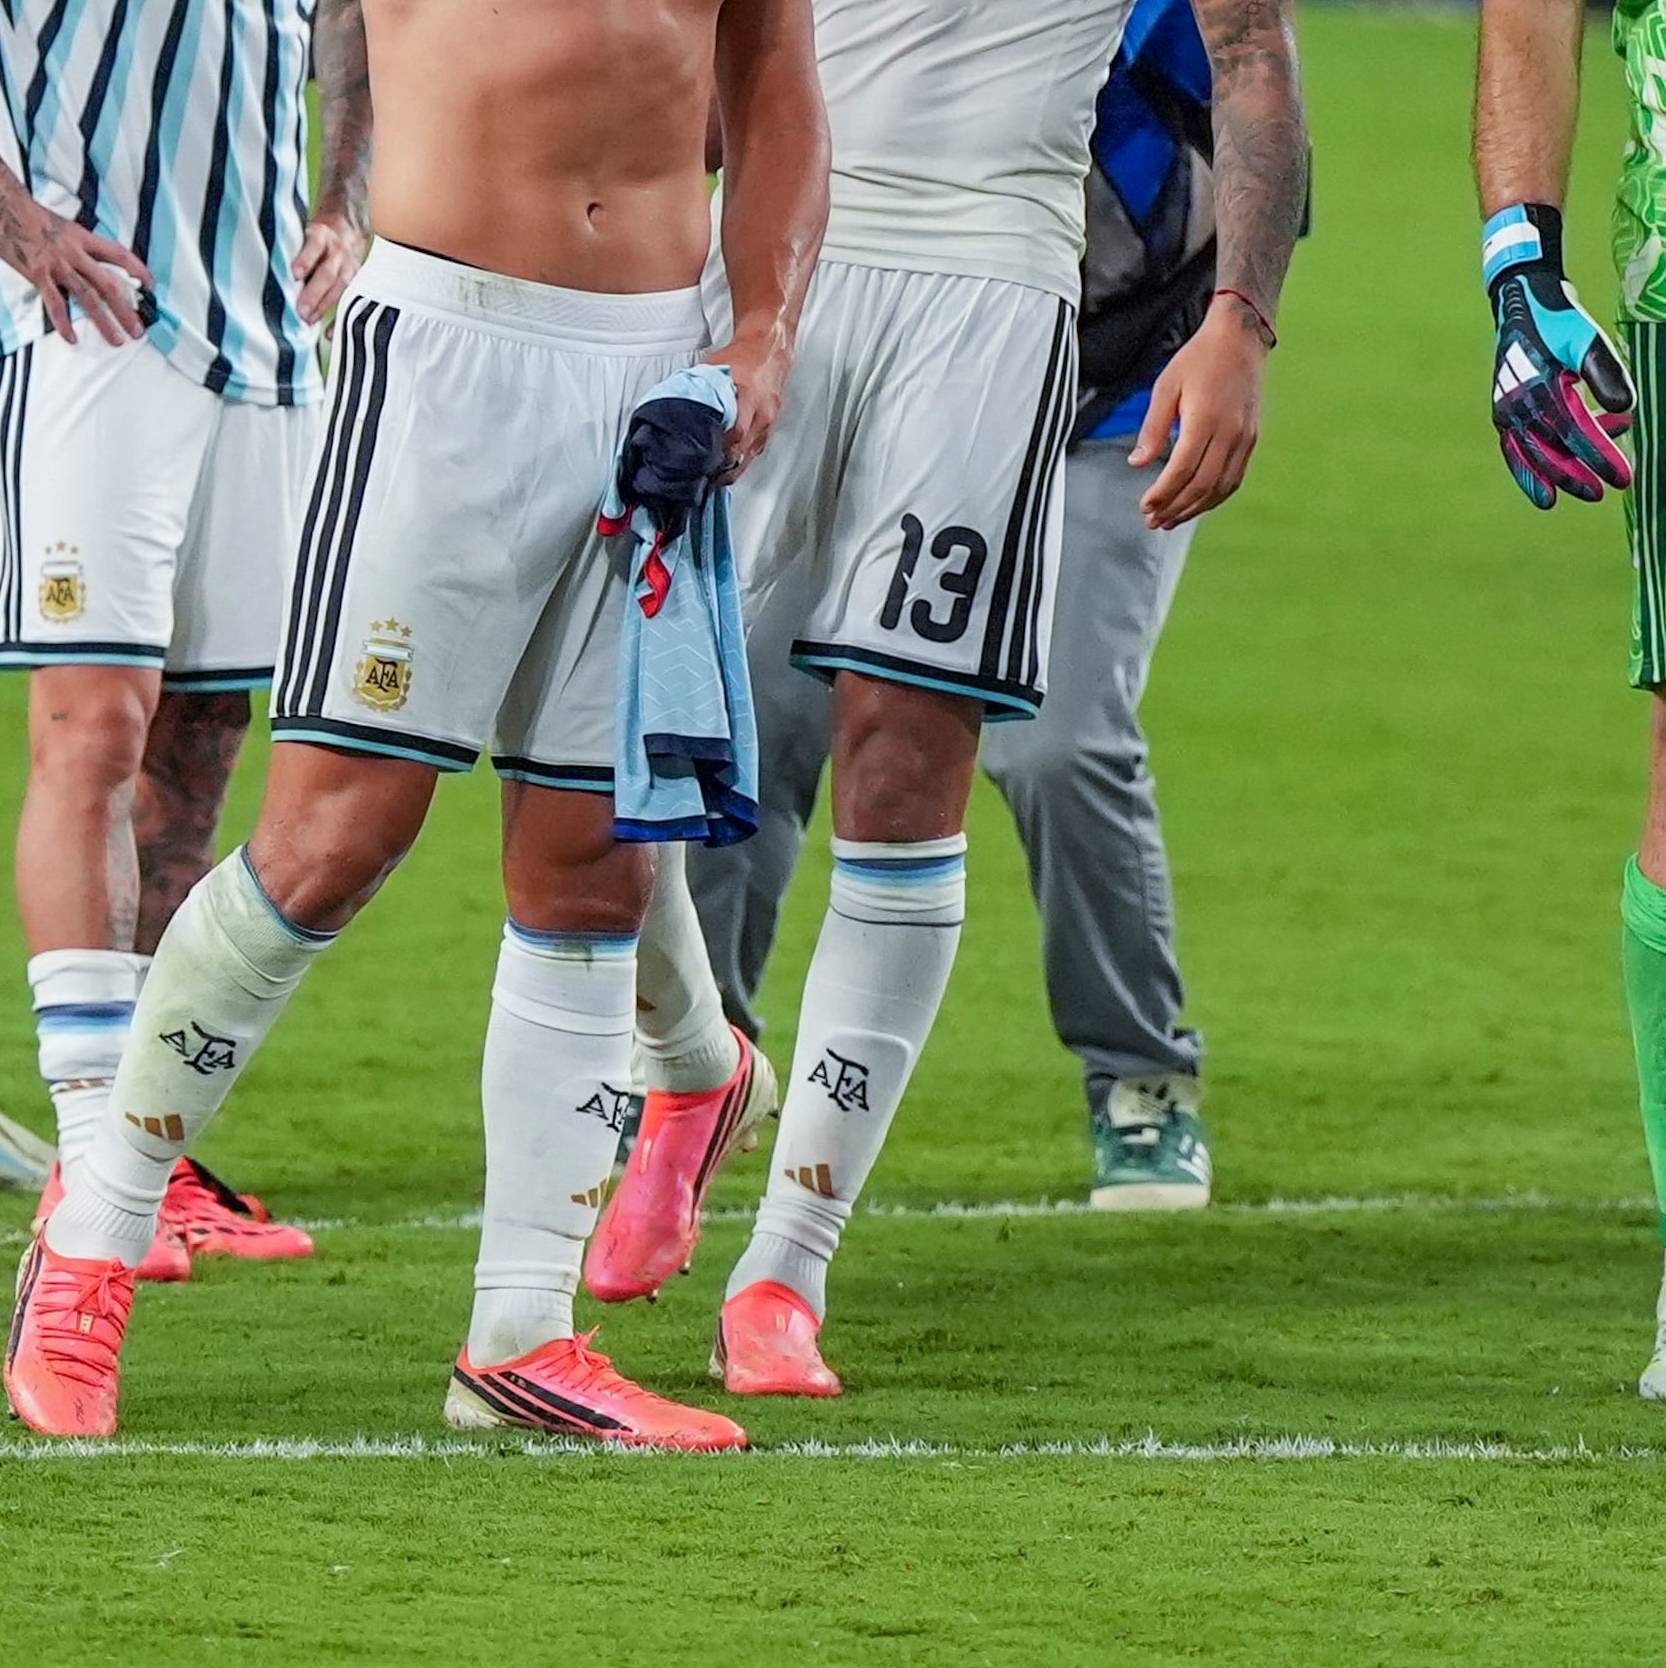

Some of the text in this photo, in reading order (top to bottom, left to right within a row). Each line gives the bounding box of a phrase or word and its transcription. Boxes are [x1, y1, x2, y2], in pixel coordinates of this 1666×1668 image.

[880, 512, 988, 644] 13
[365, 657, 400, 693] AFA
[159, 1021, 237, 1075] AFA
[808, 1047, 869, 1112] AFA
